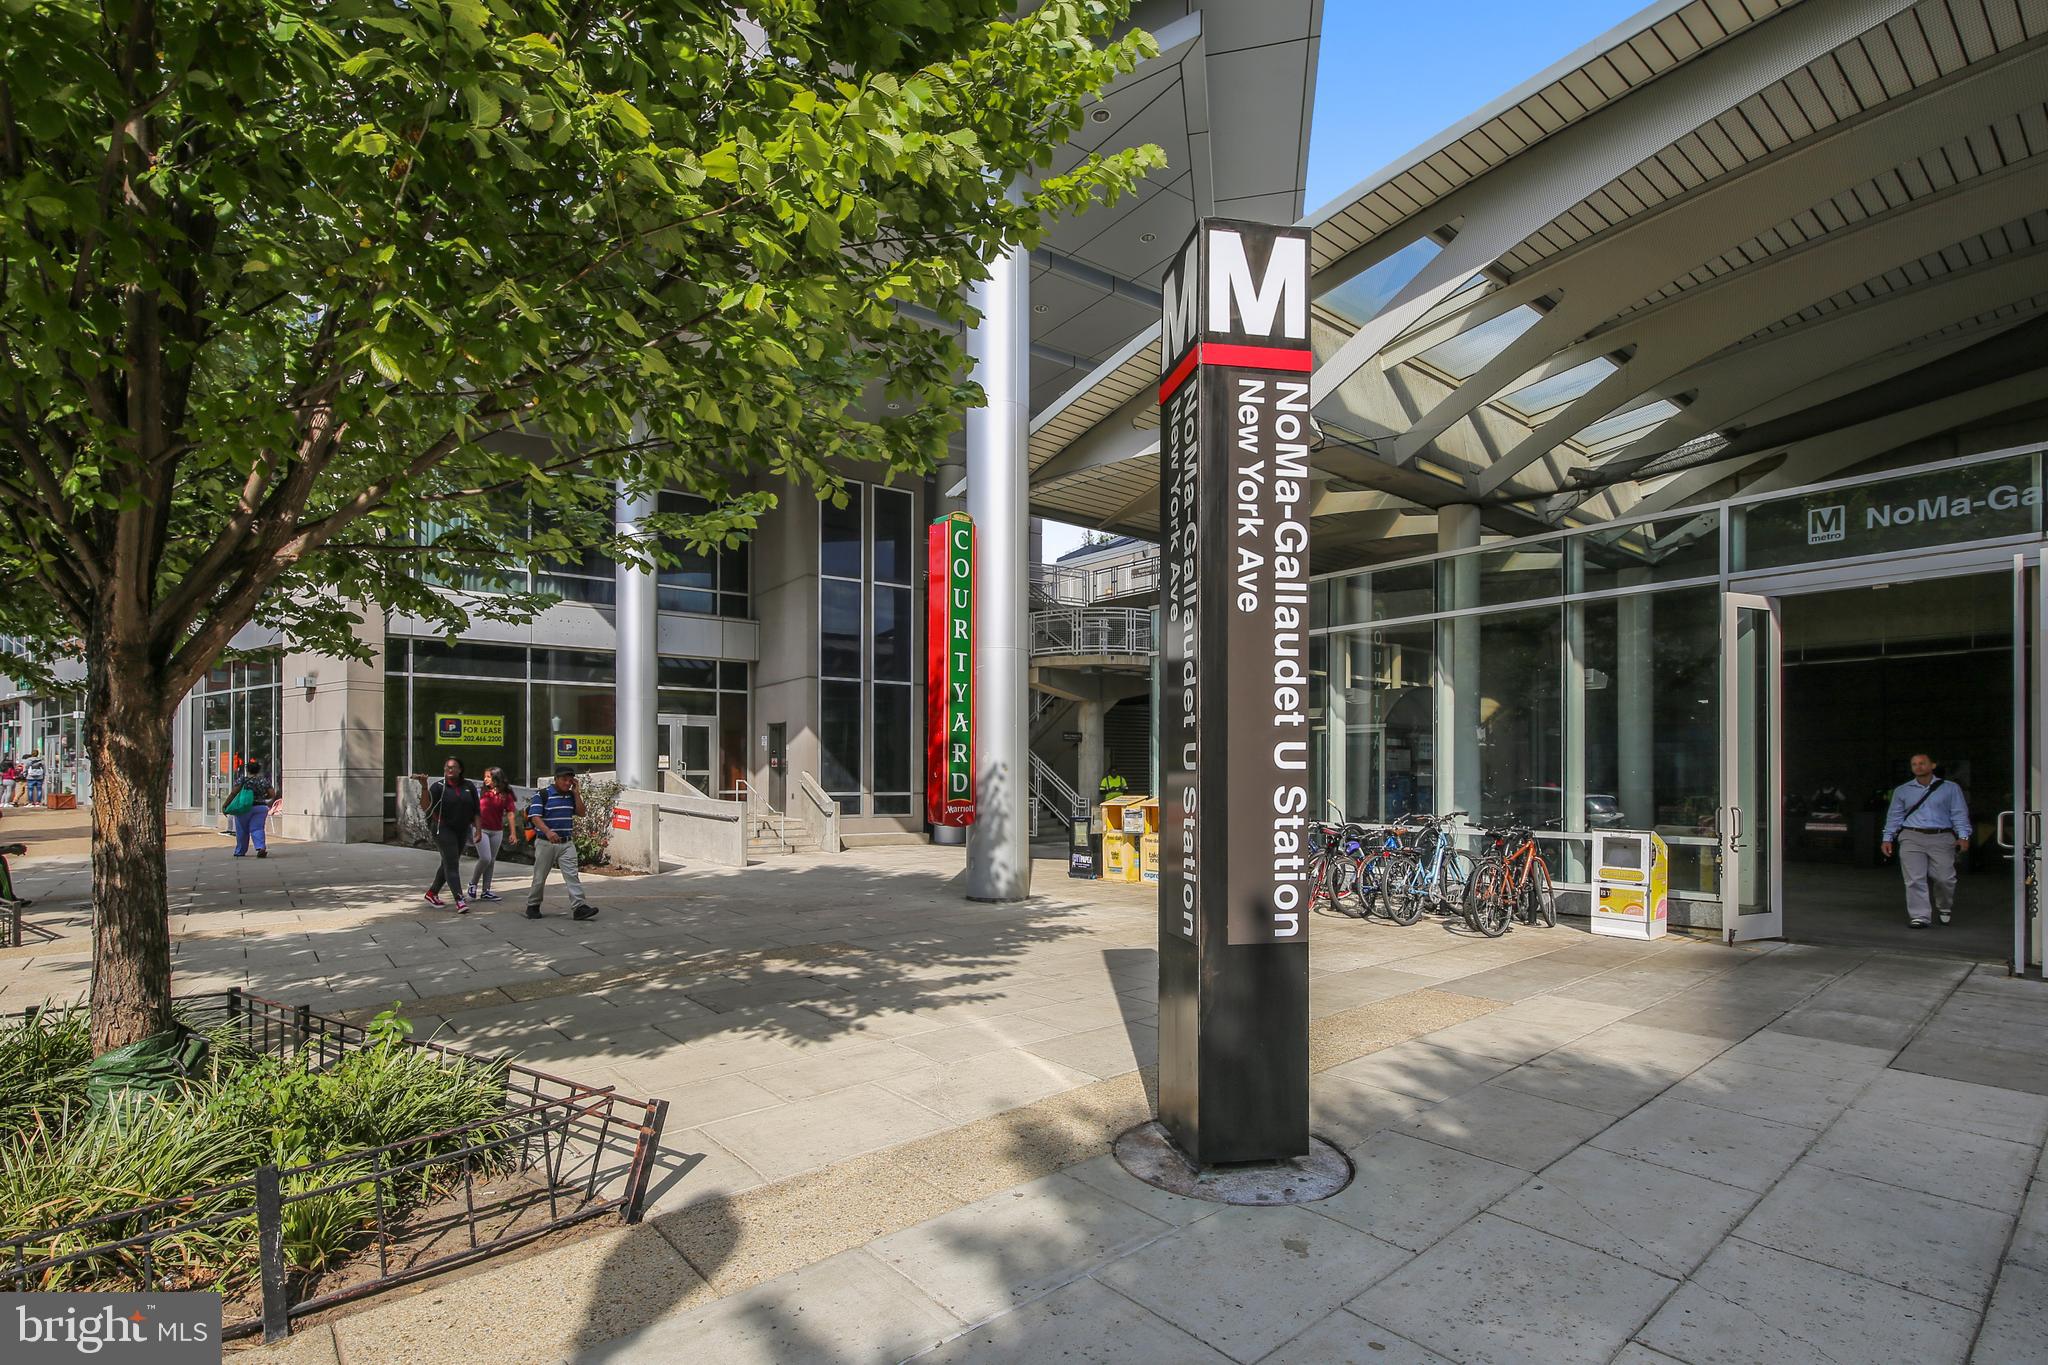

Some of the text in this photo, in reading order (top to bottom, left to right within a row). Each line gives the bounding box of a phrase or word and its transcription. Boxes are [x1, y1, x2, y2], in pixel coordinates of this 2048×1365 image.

[1160, 234, 1198, 374] M
[1208, 229, 1306, 340] M
[1169, 396, 1182, 623] New York Ave
[1237, 379, 1265, 613] New York Ave
[1811, 507, 1841, 535] M
[1811, 532, 1842, 543] metro
[952, 529, 970, 793] COURTYARD
[1183, 379, 1198, 937] NoMa-Gallaudet U Station
[1273, 381, 1309, 938] NoMa-Gallaudet U Station
[463, 726, 478, 734] FOR
[463, 735, 503, 743] 202.466.2200
[578, 745, 592, 753] FOR
